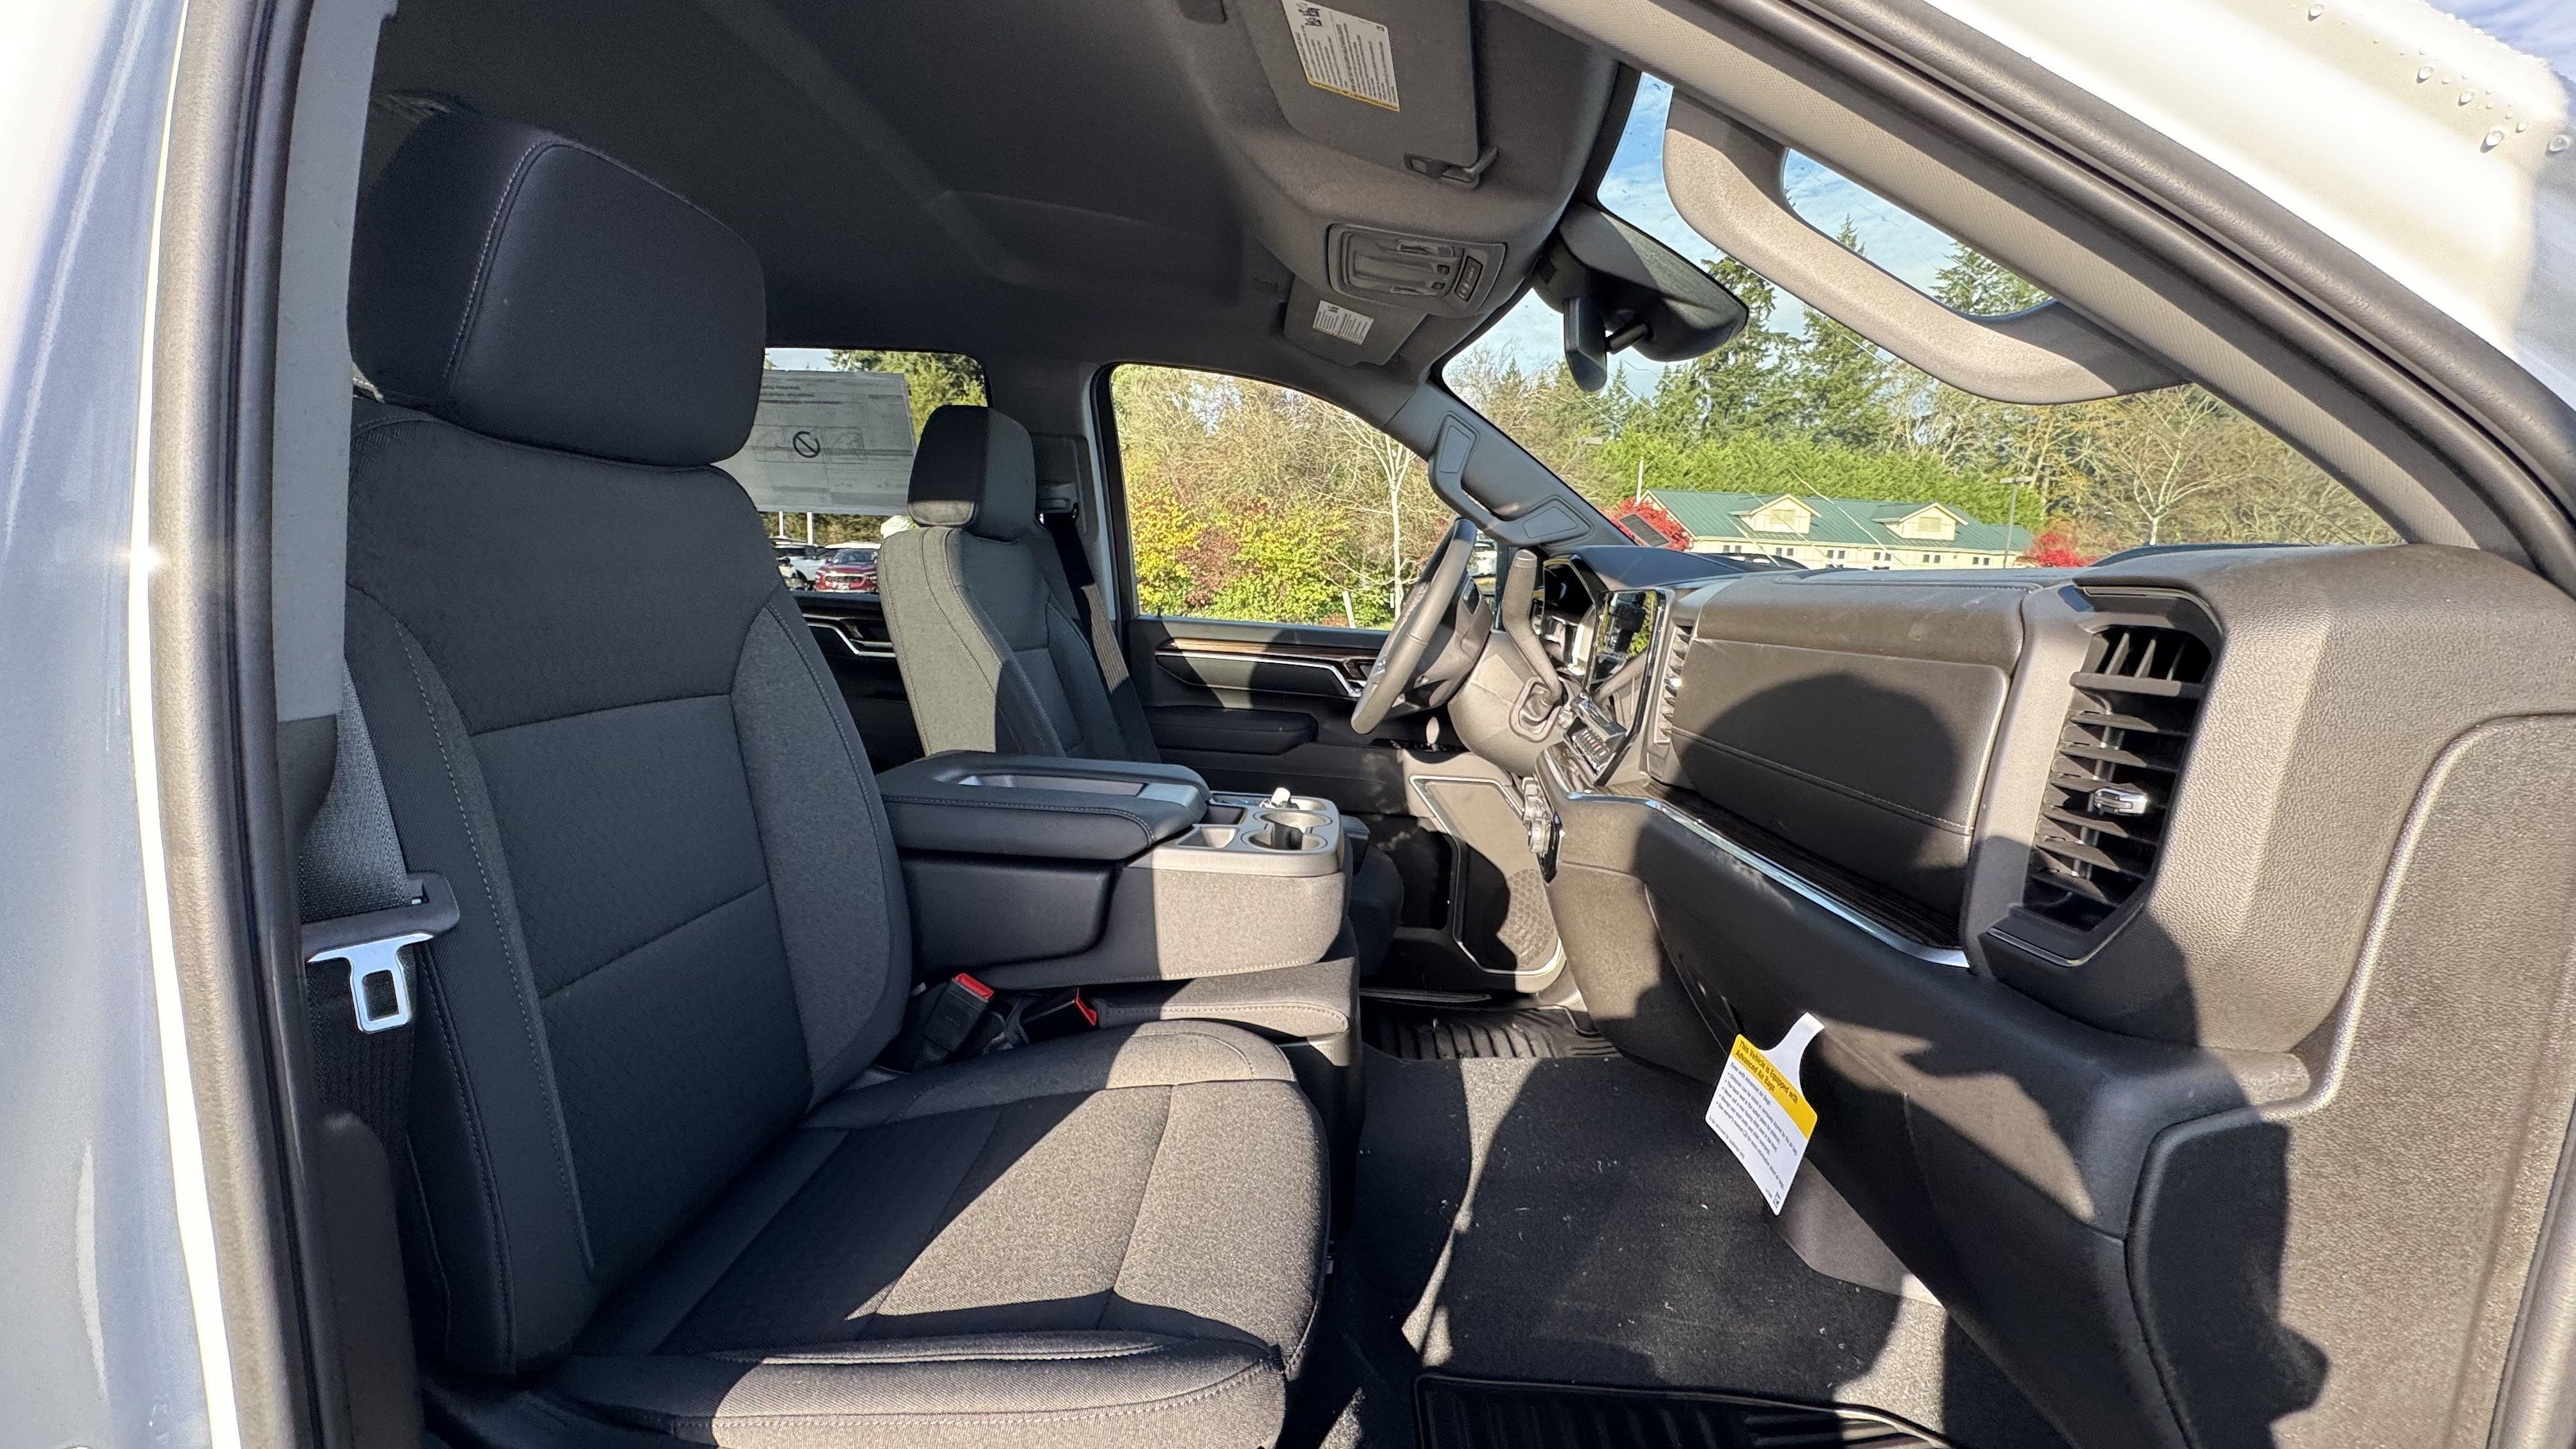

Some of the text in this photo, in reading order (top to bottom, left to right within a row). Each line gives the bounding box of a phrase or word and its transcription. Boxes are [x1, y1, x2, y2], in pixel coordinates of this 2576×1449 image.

[1735, 1049, 1775, 1092] Advanced Air Bags
[1738, 1039, 1749, 1054] This
[1749, 1048, 1766, 1070] Vehicle
[1770, 1069, 1790, 1094] Equipped
[1788, 1090, 1798, 1105] with
